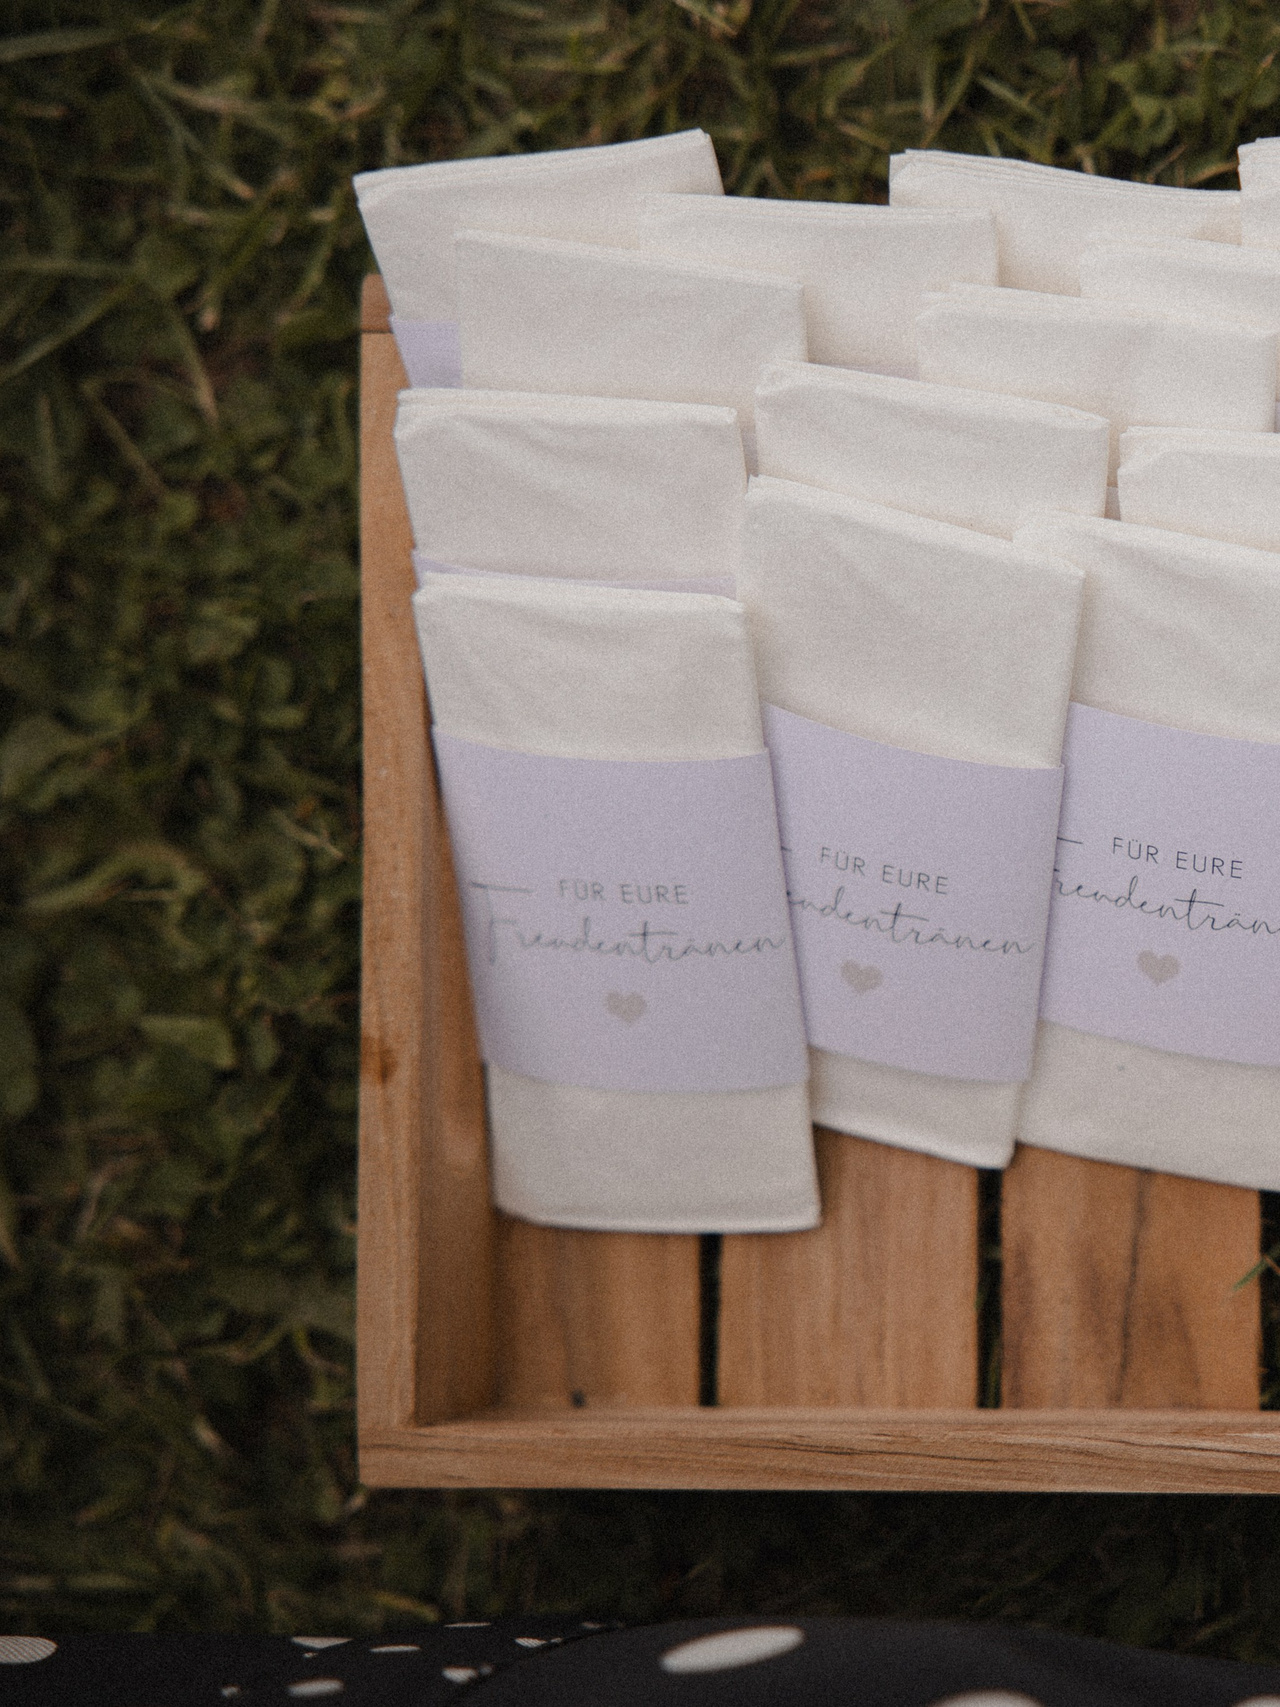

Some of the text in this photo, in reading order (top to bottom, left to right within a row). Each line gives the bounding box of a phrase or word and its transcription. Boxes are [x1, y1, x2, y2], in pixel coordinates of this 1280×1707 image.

[820, 846, 949, 895] FÜR EURE
[1112, 836, 1243, 880] FÜR EURE
[558, 879, 690, 905] FÜR EURE
